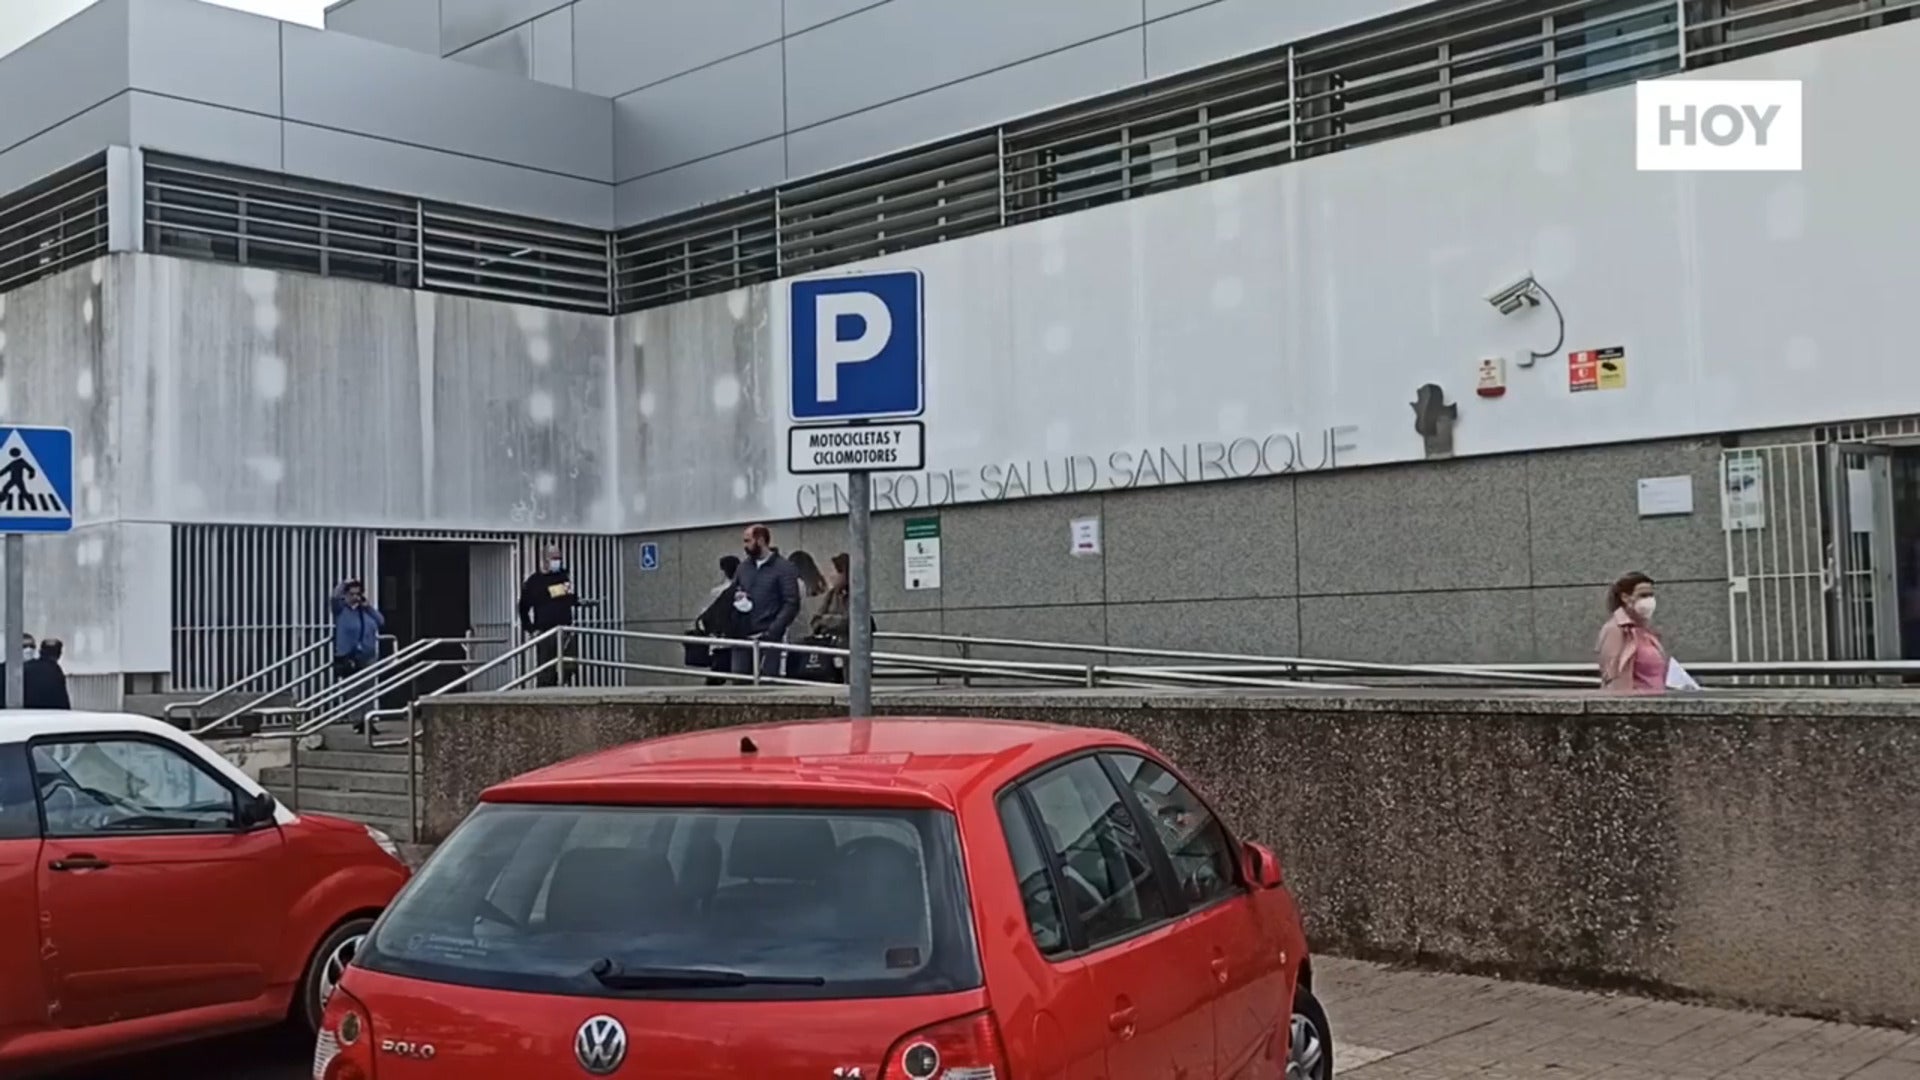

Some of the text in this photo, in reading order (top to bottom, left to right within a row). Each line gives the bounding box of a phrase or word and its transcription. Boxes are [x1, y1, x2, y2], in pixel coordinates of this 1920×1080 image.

[815, 291, 892, 403] P
[809, 431, 901, 448] MOTOCICLETAS Y
[813, 448, 897, 465] CICLOMOTORES
[796, 425, 1359, 519] CENRO DE SALUD SAN ROQUE
[381, 1039, 436, 1060] POLO
